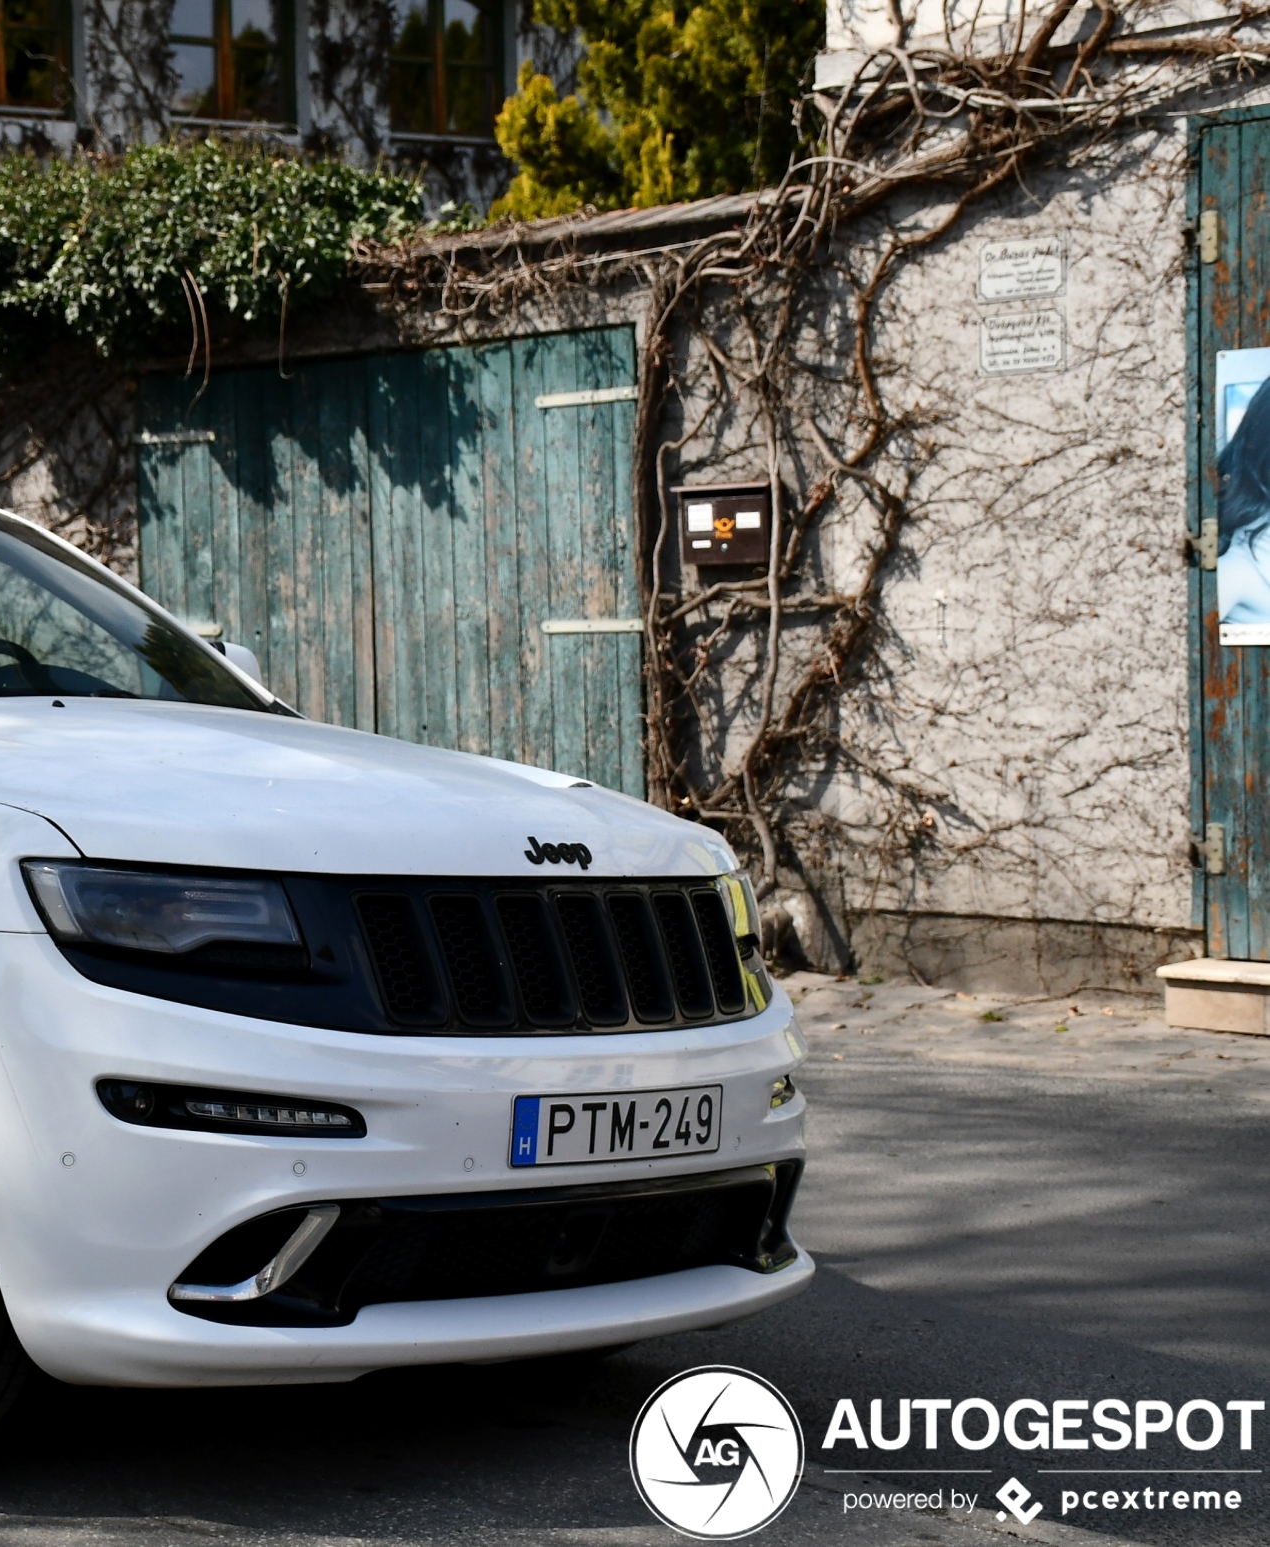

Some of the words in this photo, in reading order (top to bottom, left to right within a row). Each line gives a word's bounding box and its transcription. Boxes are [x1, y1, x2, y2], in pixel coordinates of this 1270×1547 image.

[524, 836, 592, 870] Jeep
[547, 1094, 713, 1156] PTM-249
[519, 1136, 531, 1155] H
